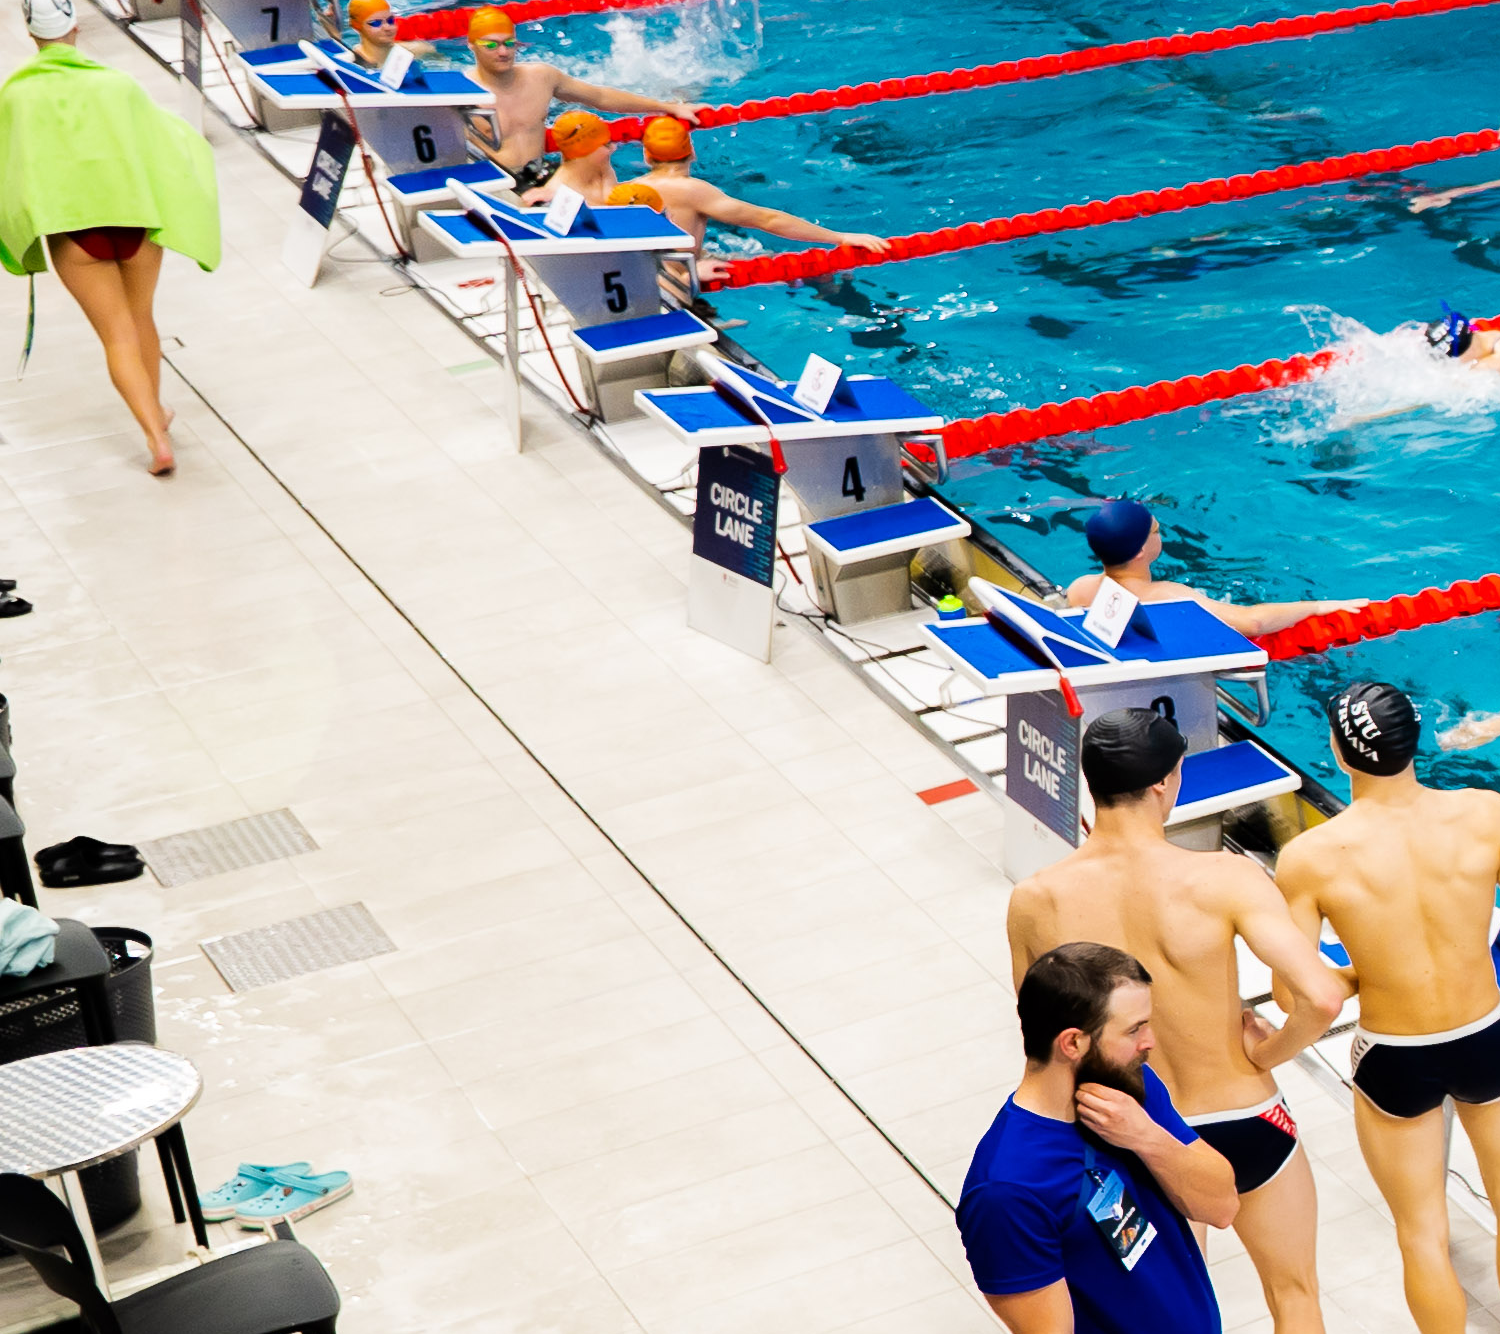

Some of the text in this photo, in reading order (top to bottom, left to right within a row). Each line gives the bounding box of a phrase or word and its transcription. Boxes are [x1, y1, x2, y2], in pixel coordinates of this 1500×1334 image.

[261, 6, 280, 42] 7
[412, 124, 437, 164] 6
[603, 270, 629, 314] 5
[841, 456, 867, 503] 4
[710, 482, 764, 525] CIRCLE
[715, 511, 755, 549] LANE
[1337, 694, 1380, 763] TRNAVA
[1350, 700, 1382, 740] STU
[1018, 719, 1067, 775] CIRCLE
[1023, 753, 1061, 801] LANE
